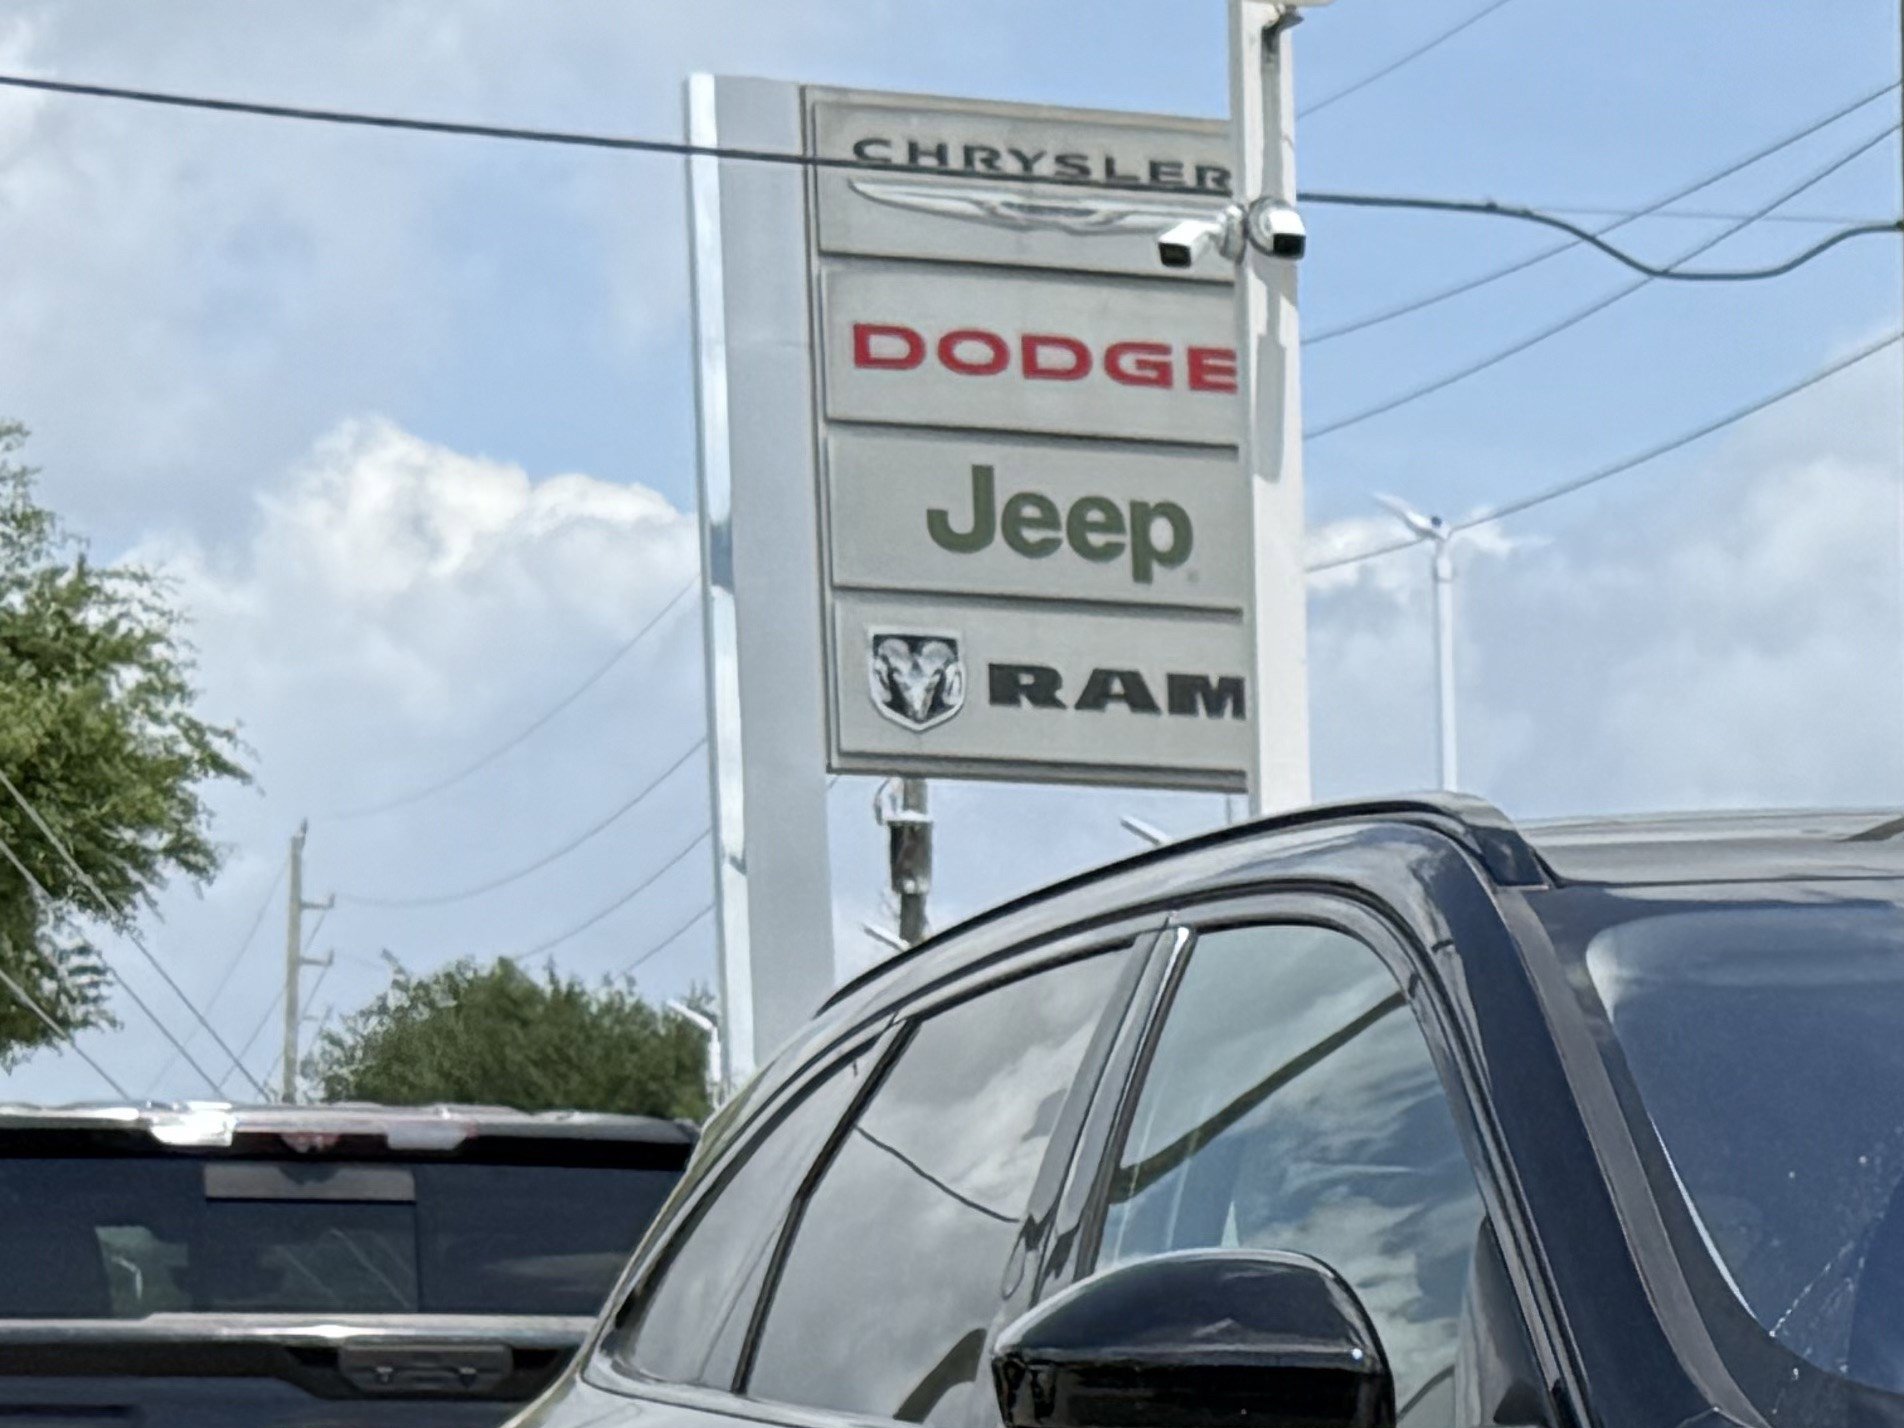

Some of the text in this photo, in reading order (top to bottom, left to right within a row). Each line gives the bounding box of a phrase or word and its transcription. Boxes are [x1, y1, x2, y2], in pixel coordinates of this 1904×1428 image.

[852, 136, 1234, 198] CHRYSLER
[852, 322, 1238, 394] DODGE
[926, 464, 1194, 584] Jeep
[988, 662, 1247, 720] RAM
